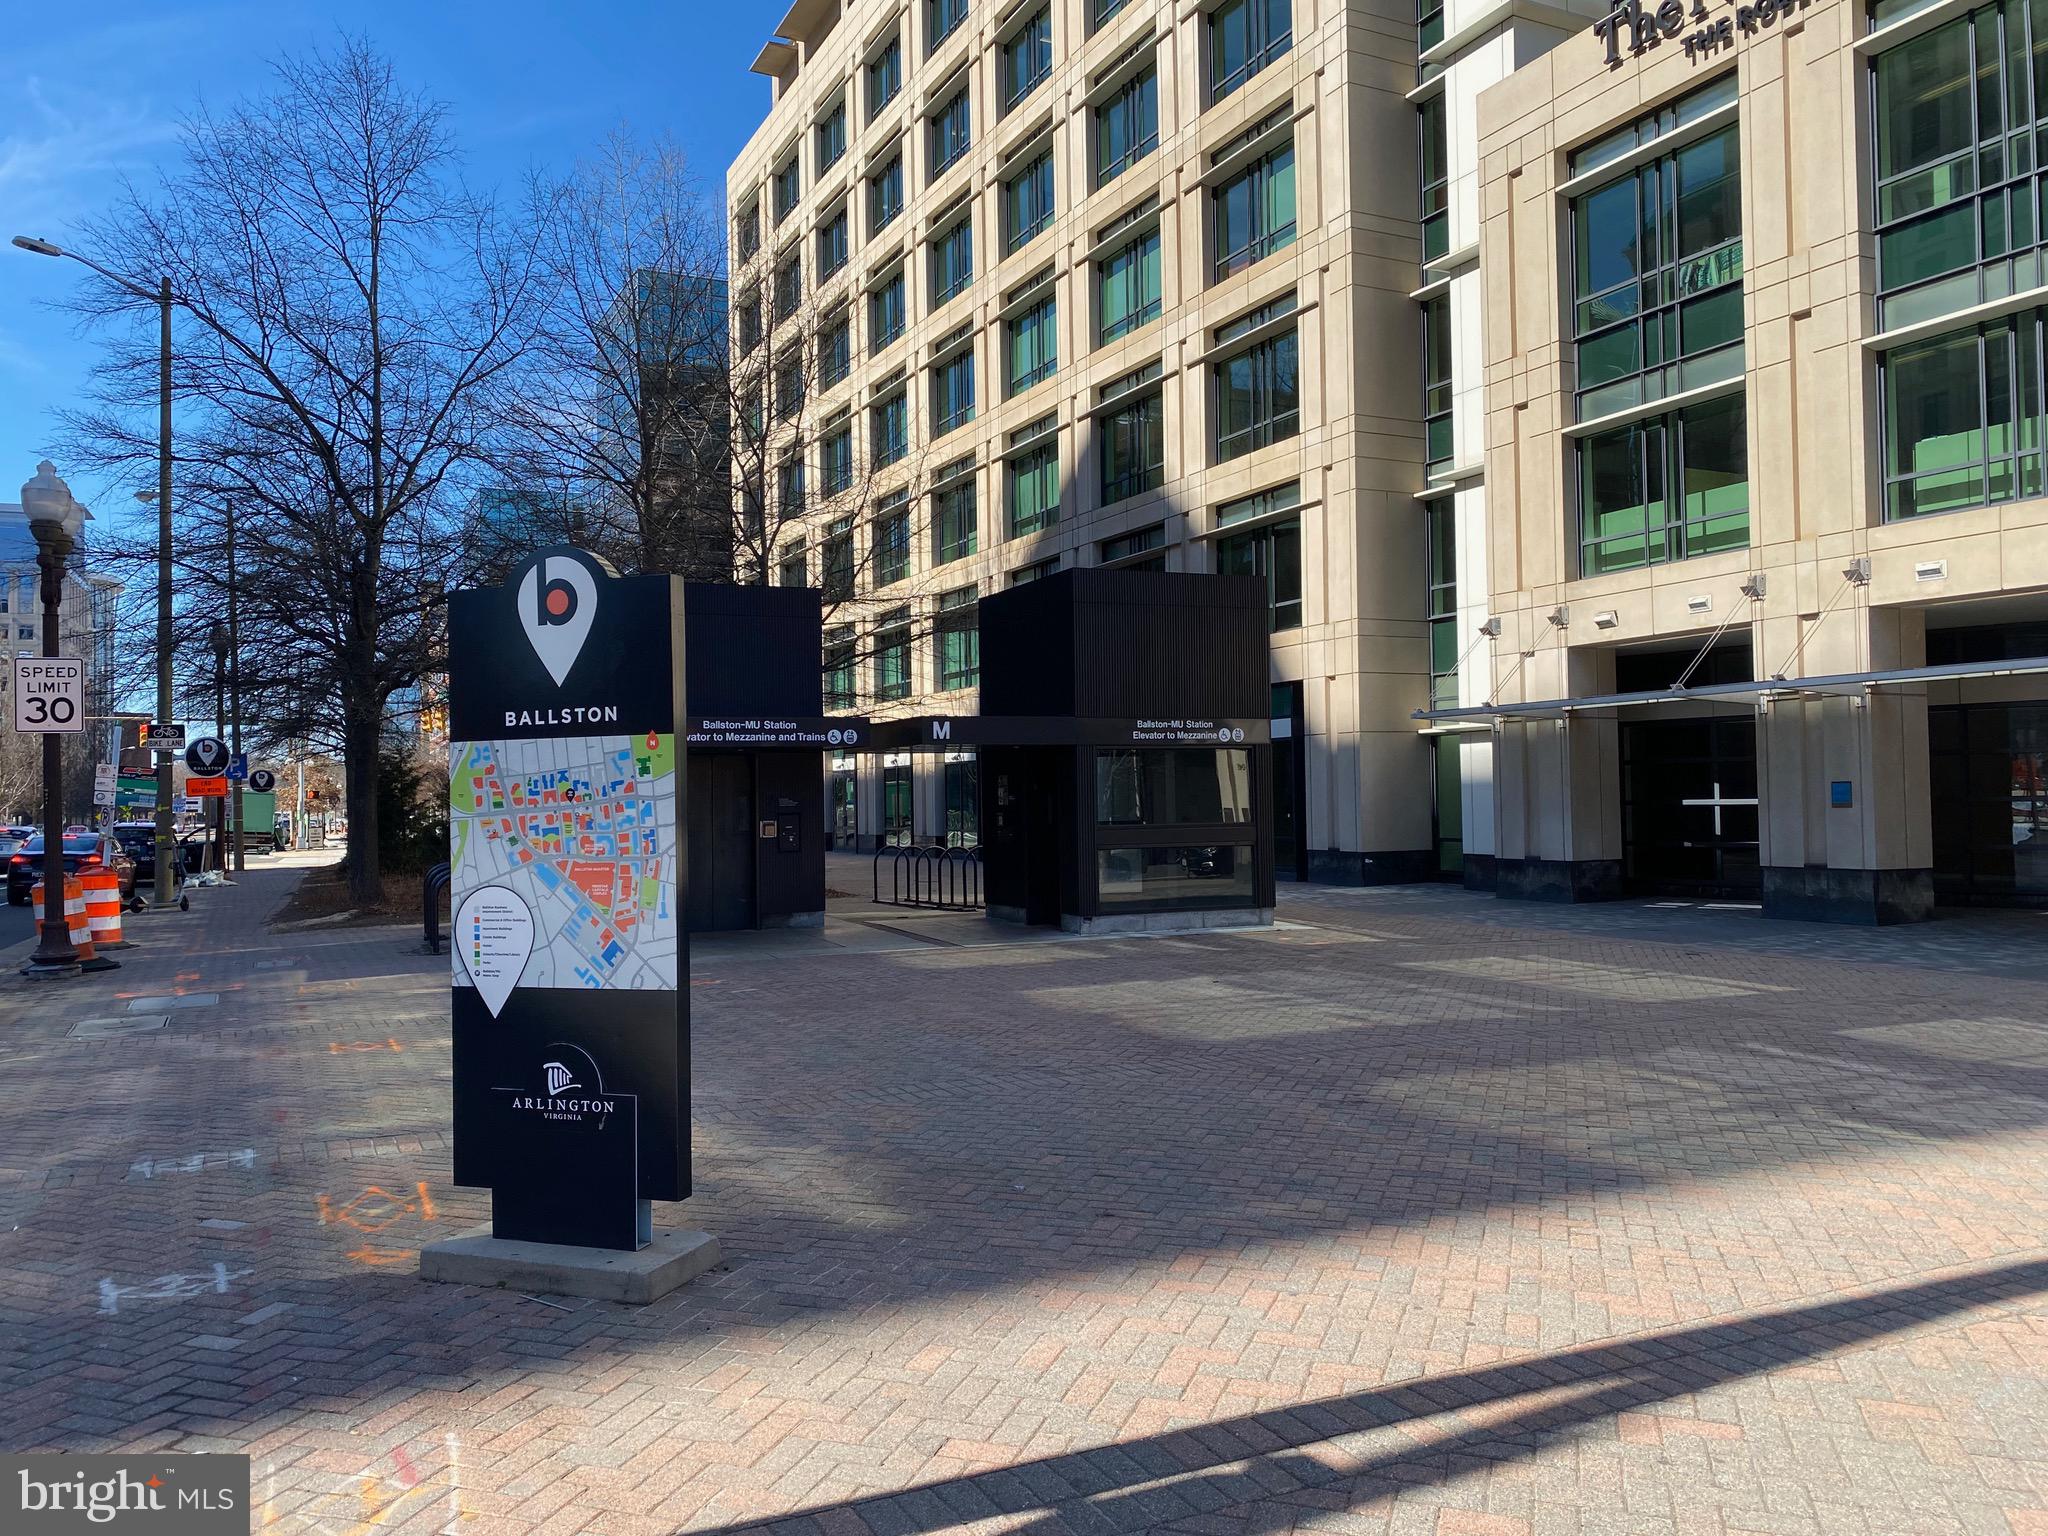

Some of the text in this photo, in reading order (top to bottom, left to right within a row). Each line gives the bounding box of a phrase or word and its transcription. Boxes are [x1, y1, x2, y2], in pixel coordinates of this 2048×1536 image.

[1594, 0, 1684, 65] The
[1680, 16, 1734, 58] THE
[20, 666, 78, 678] SPEED
[27, 682, 71, 693] LIMIT
[24, 696, 75, 724] 30
[505, 705, 618, 727] BALLSTON
[702, 720, 797, 730] Ballston-MU Station
[1136, 719, 1214, 729] Ballston-MU Station
[932, 721, 950, 740] M
[1132, 730, 1218, 740] Elevator to Mezzanine
[687, 732, 826, 742] vator to Mezzanine and Trains
[149, 740, 184, 748] BIKE LANE
[512, 1097, 615, 1113] ARLINGTON
[543, 1112, 582, 1121] VIRGINIA
